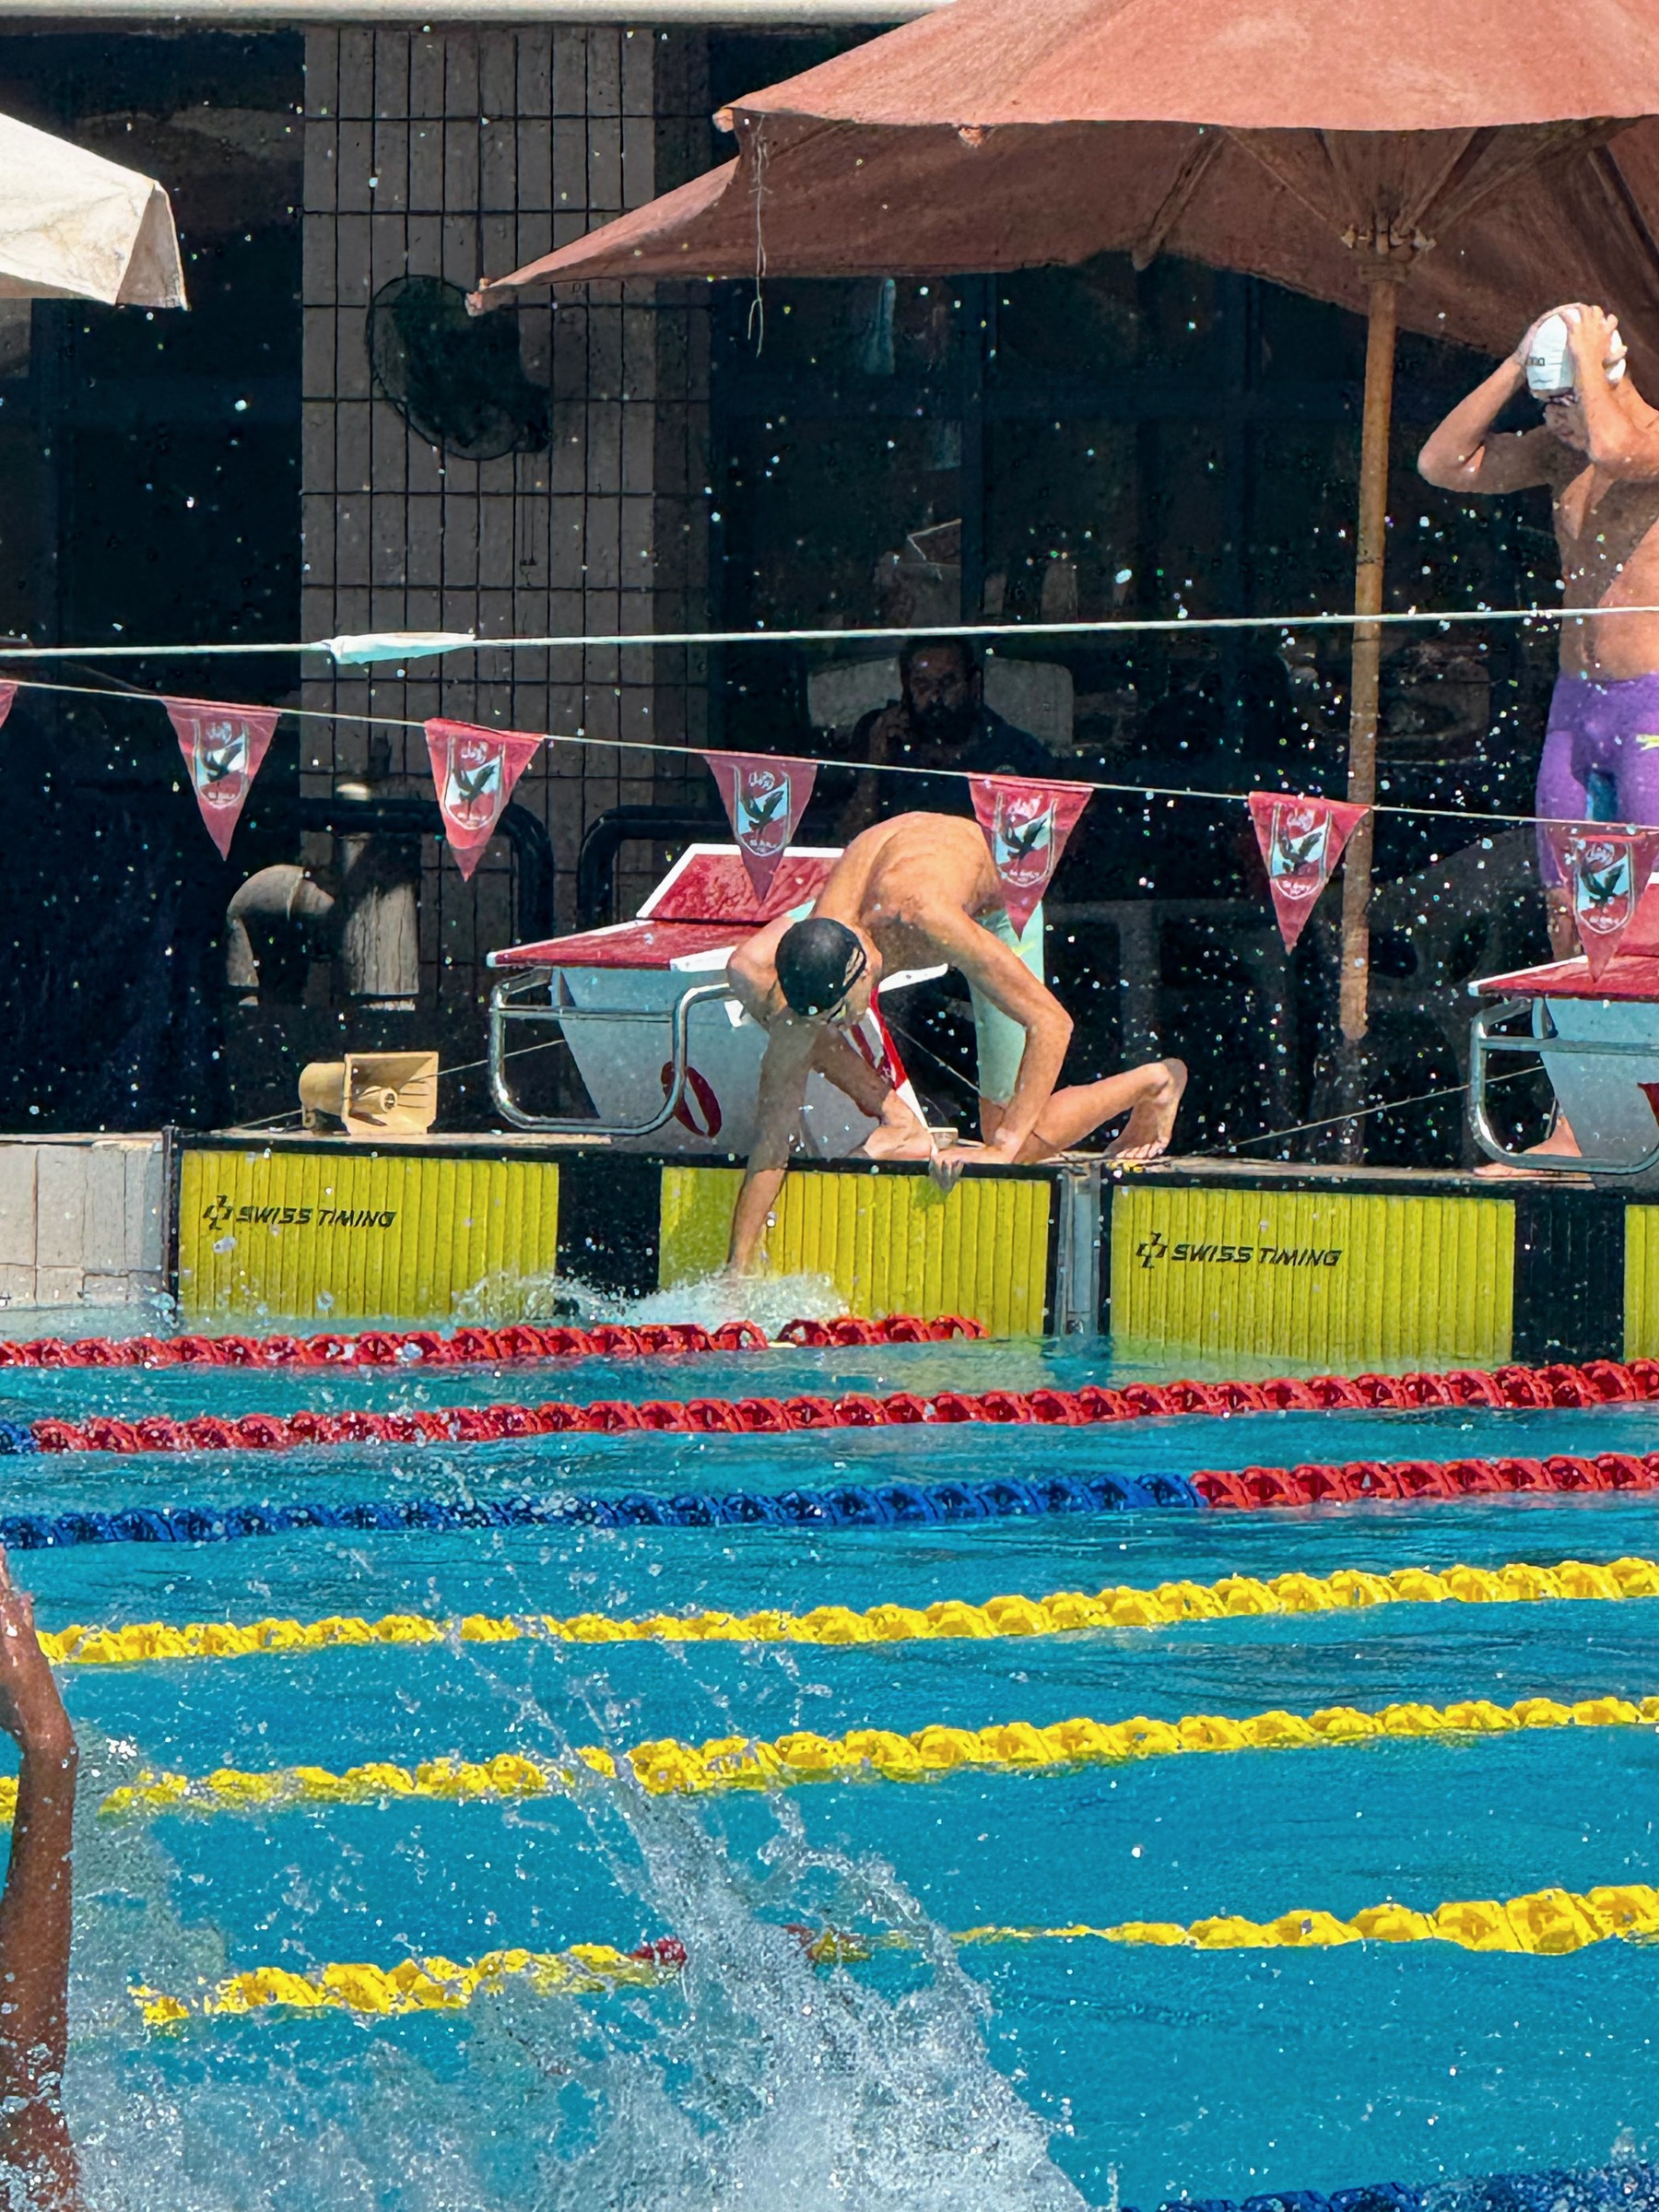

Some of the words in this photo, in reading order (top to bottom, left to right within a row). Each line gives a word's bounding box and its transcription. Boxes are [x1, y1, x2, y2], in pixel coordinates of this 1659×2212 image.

[236, 1206, 313, 1225] SWISS
[319, 1209, 396, 1229] TIMING
[1171, 1244, 1253, 1263] SWISS
[1259, 1247, 1342, 1267] TIMING
